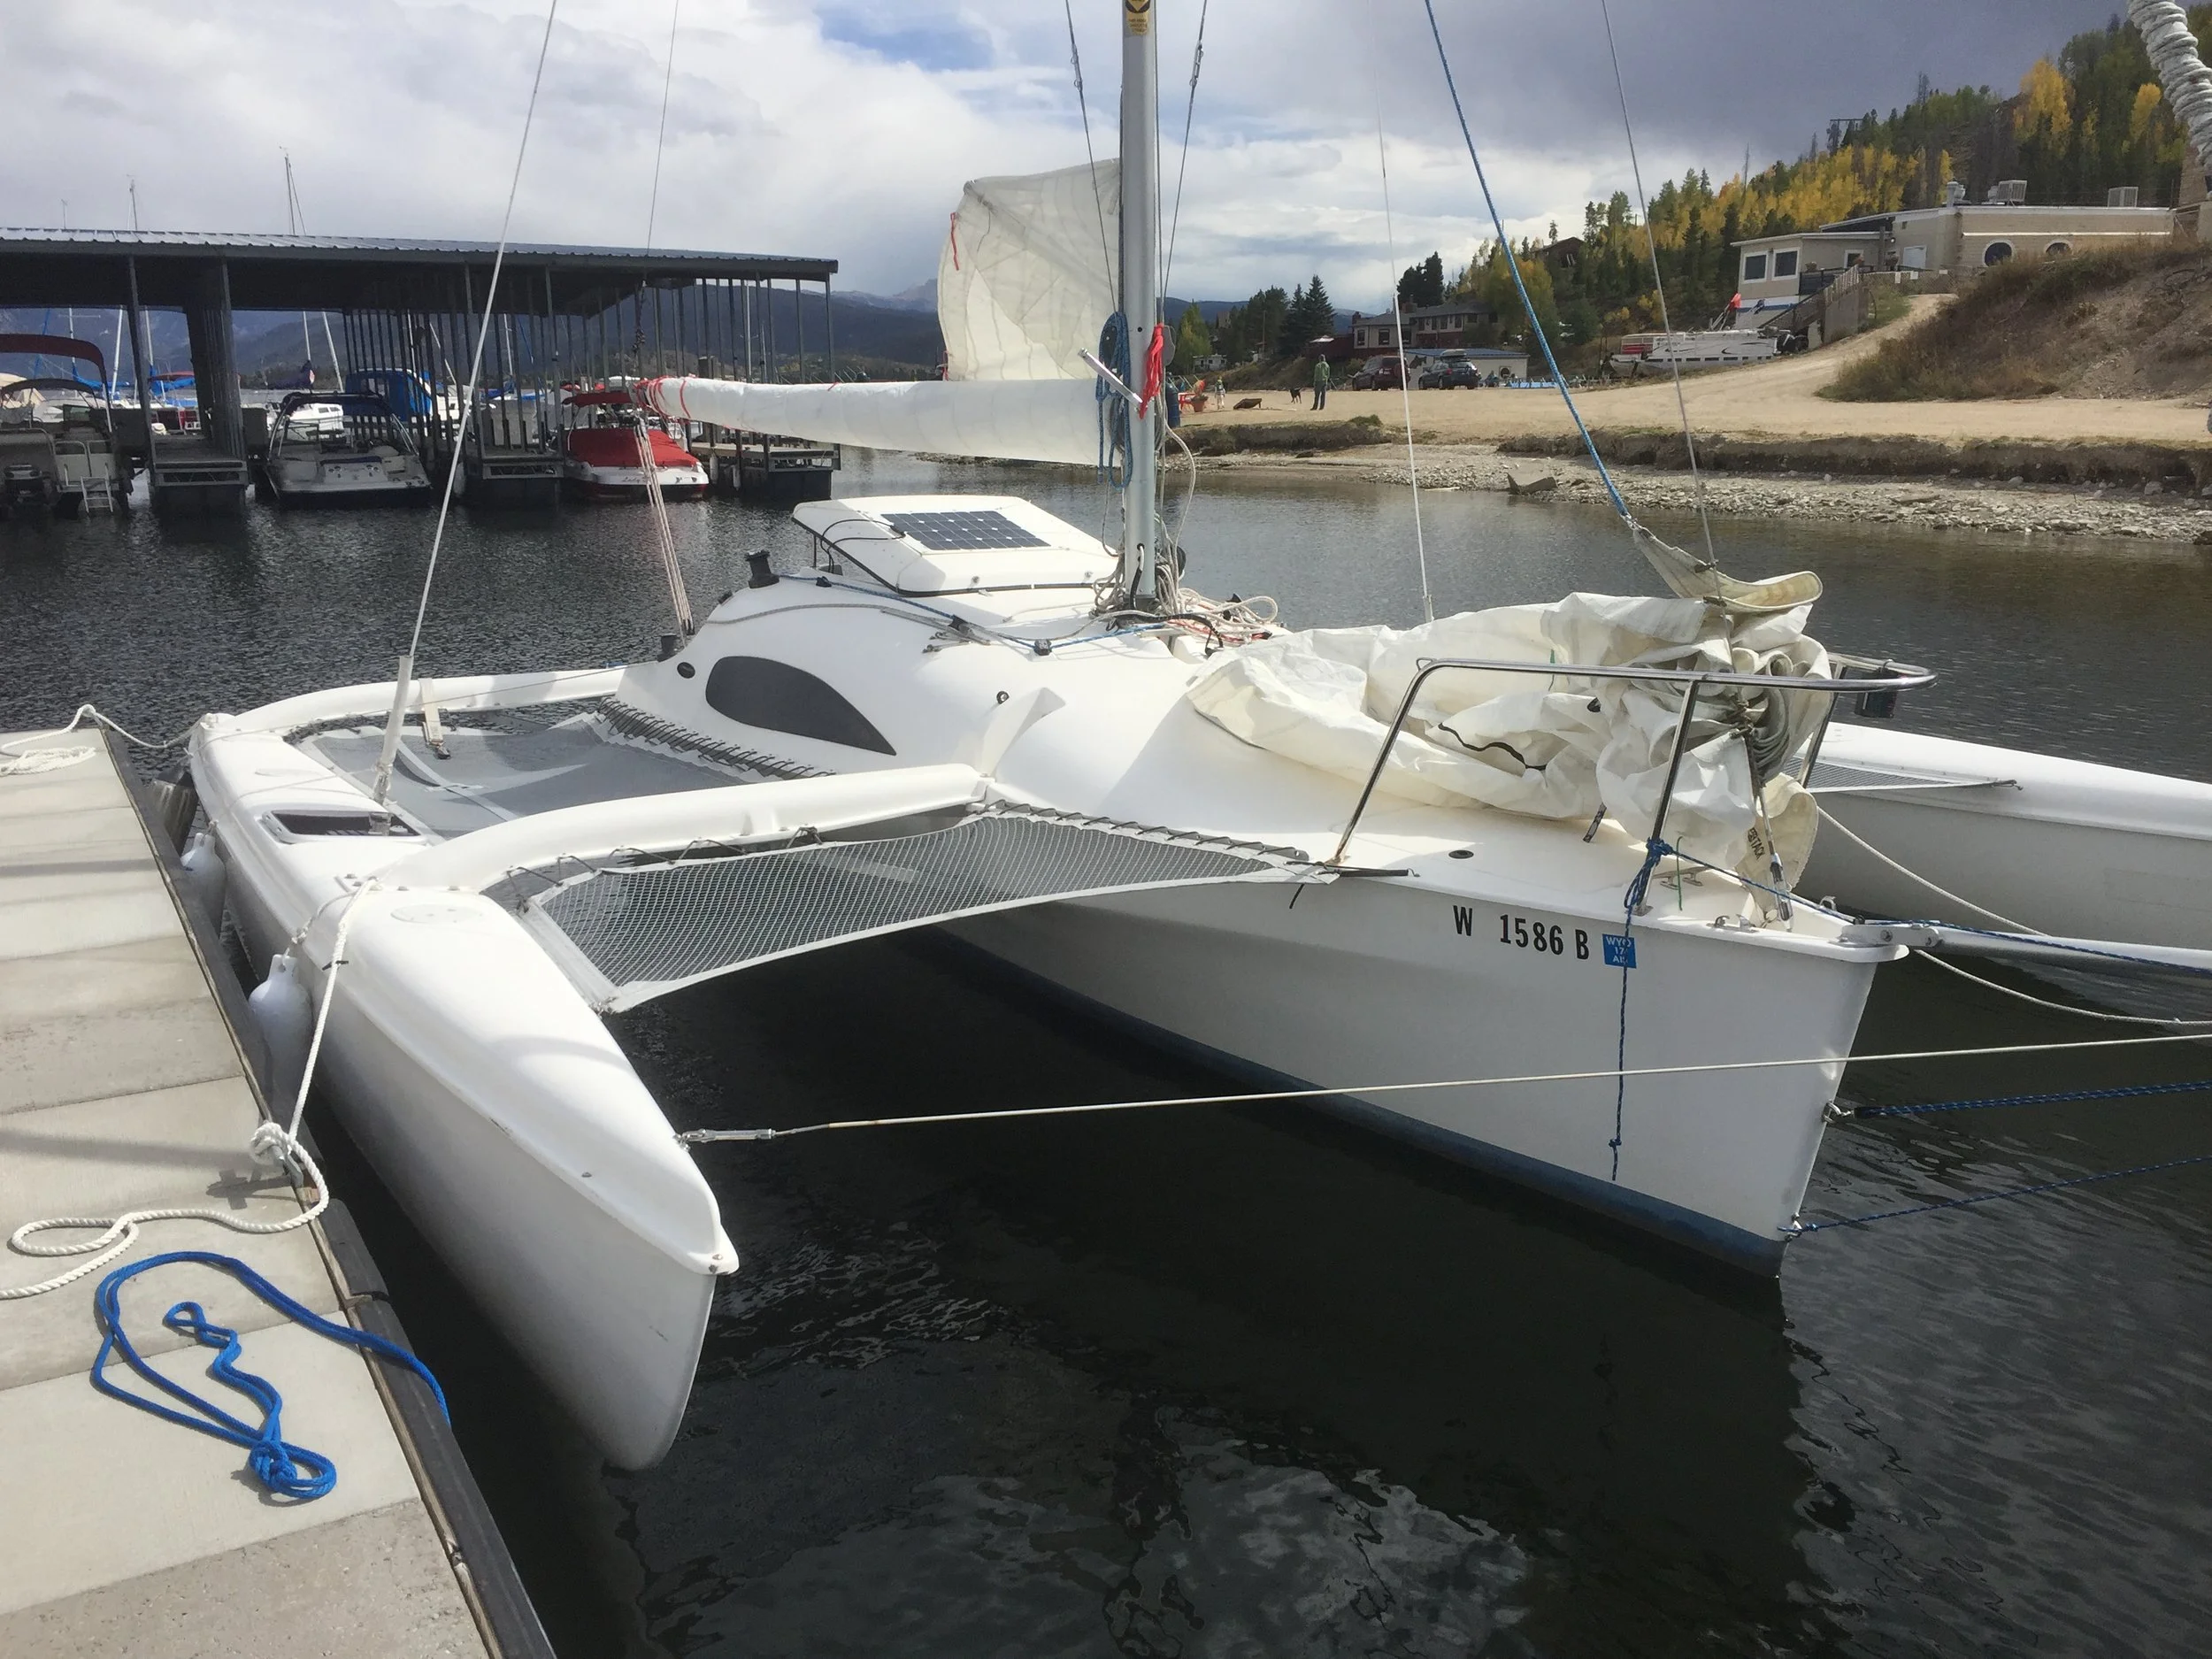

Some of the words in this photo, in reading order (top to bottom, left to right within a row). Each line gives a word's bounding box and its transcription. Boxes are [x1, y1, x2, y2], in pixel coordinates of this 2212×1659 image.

[1452, 905, 1473, 937] W
[1500, 914, 1563, 956] 1586
[1575, 929, 1589, 960] B
